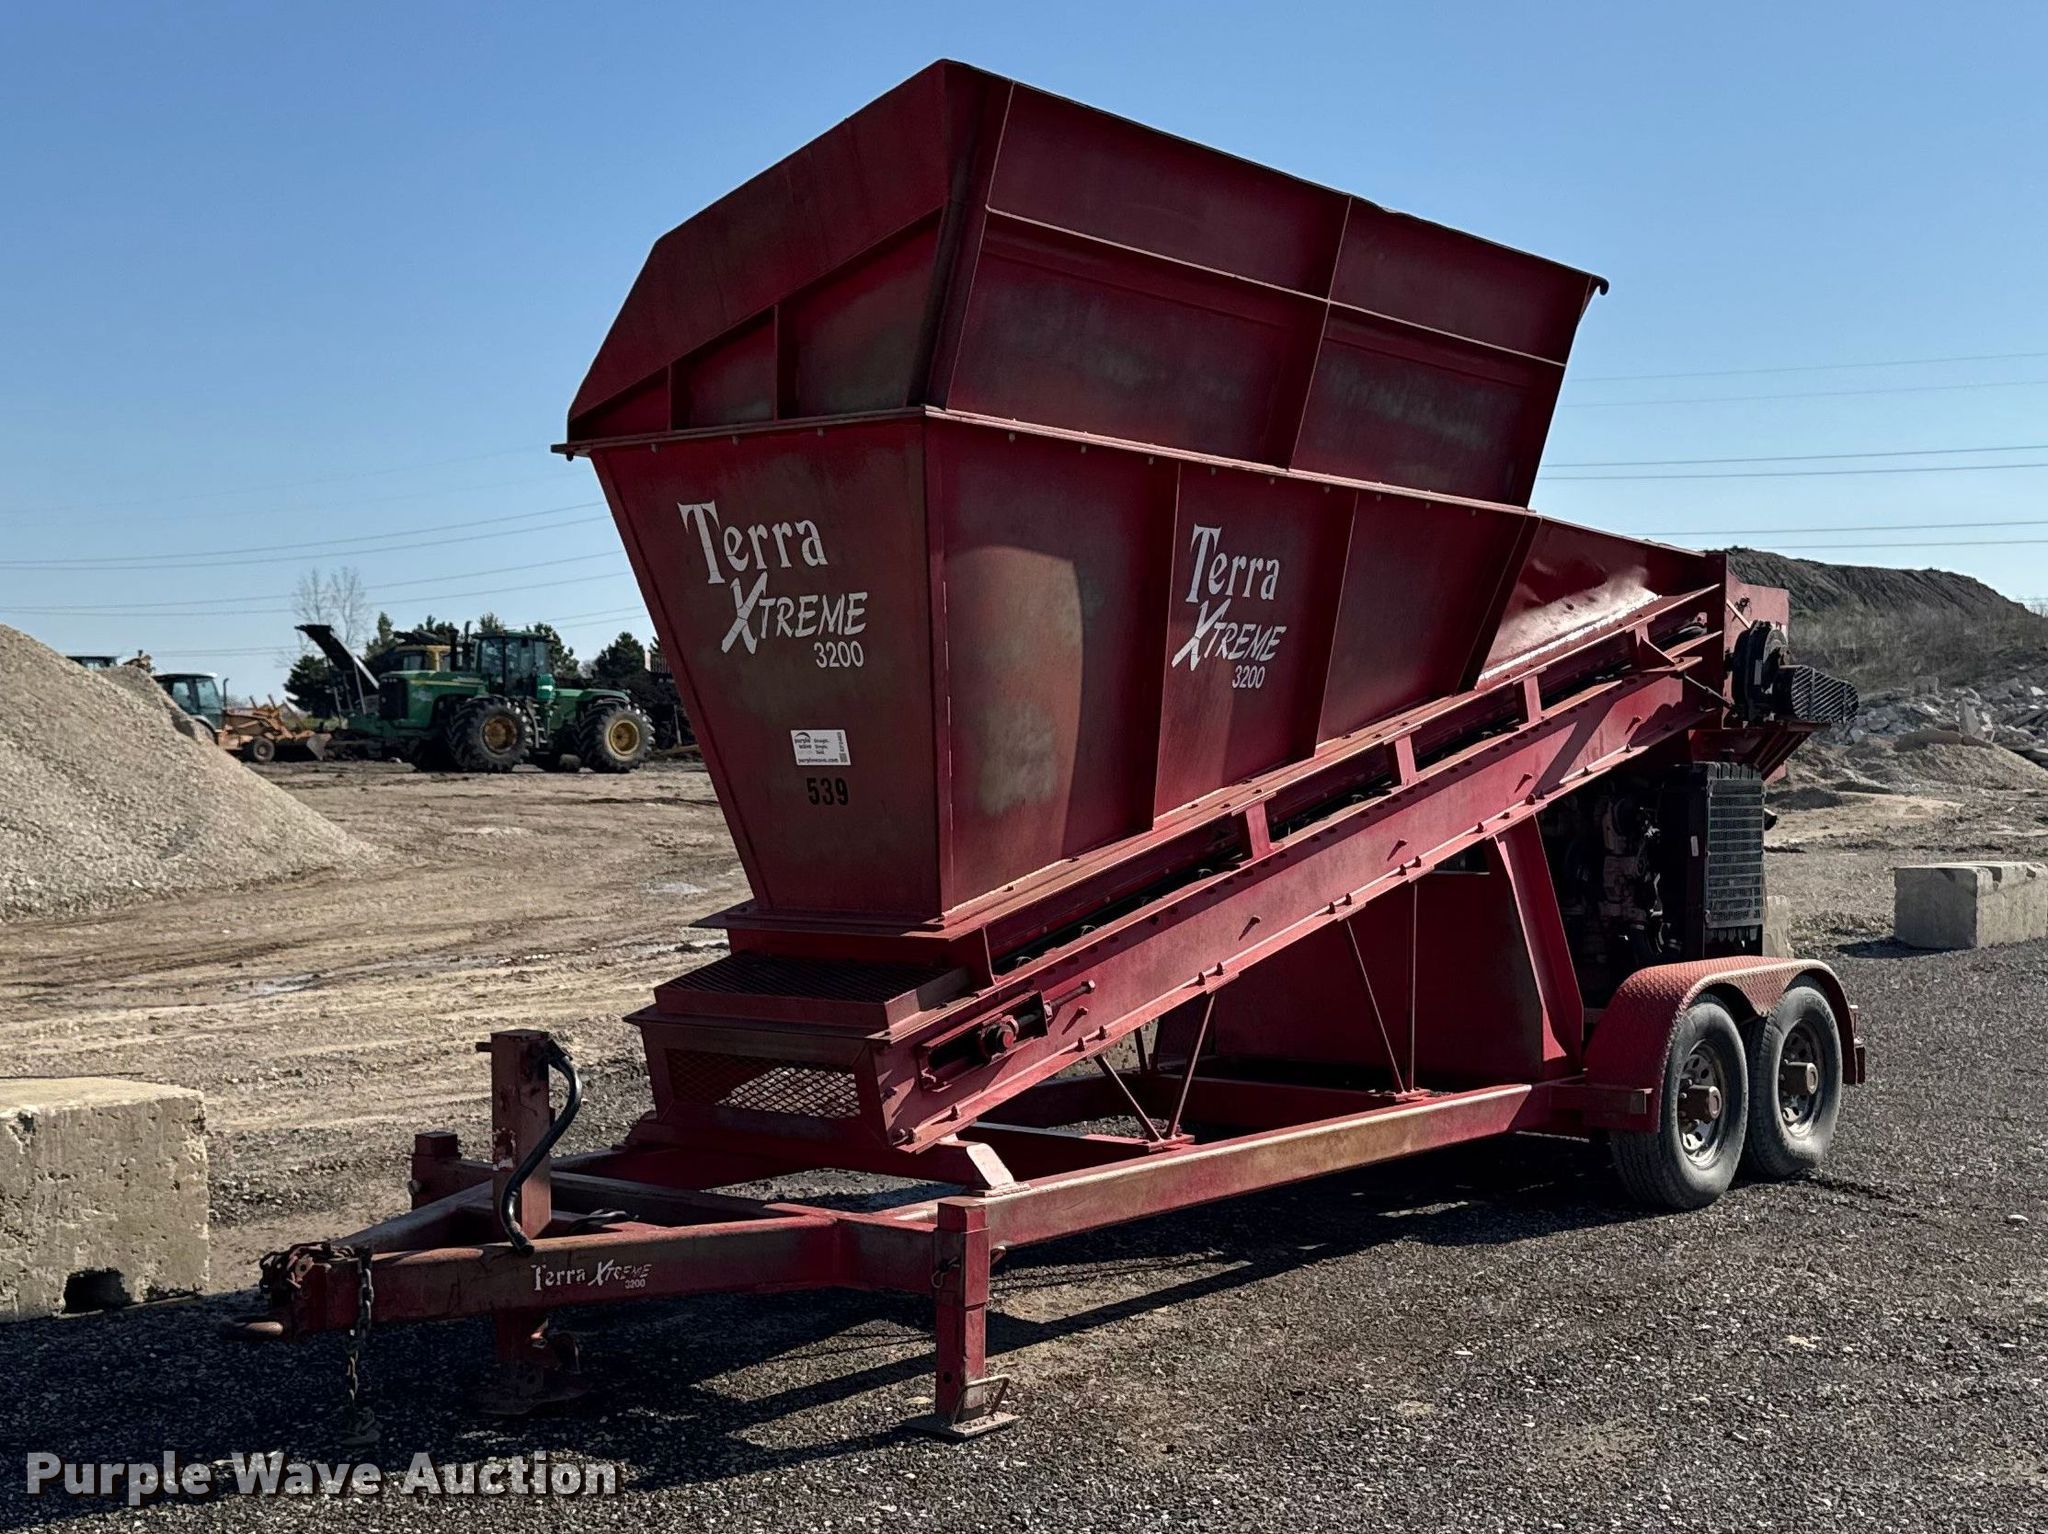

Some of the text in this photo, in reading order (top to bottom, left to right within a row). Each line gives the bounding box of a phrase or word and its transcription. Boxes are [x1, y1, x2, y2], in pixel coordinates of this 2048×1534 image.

[677, 500, 828, 584] Terra
[1185, 523, 1280, 603] Terra
[721, 571, 868, 655] XTREME
[1171, 598, 1287, 671] XTREME
[814, 641, 865, 668] 3200
[1232, 665, 1265, 689] 3200
[806, 777, 849, 806] 539
[530, 1264, 586, 1291] Terra
[625, 1279, 646, 1289] 3200
